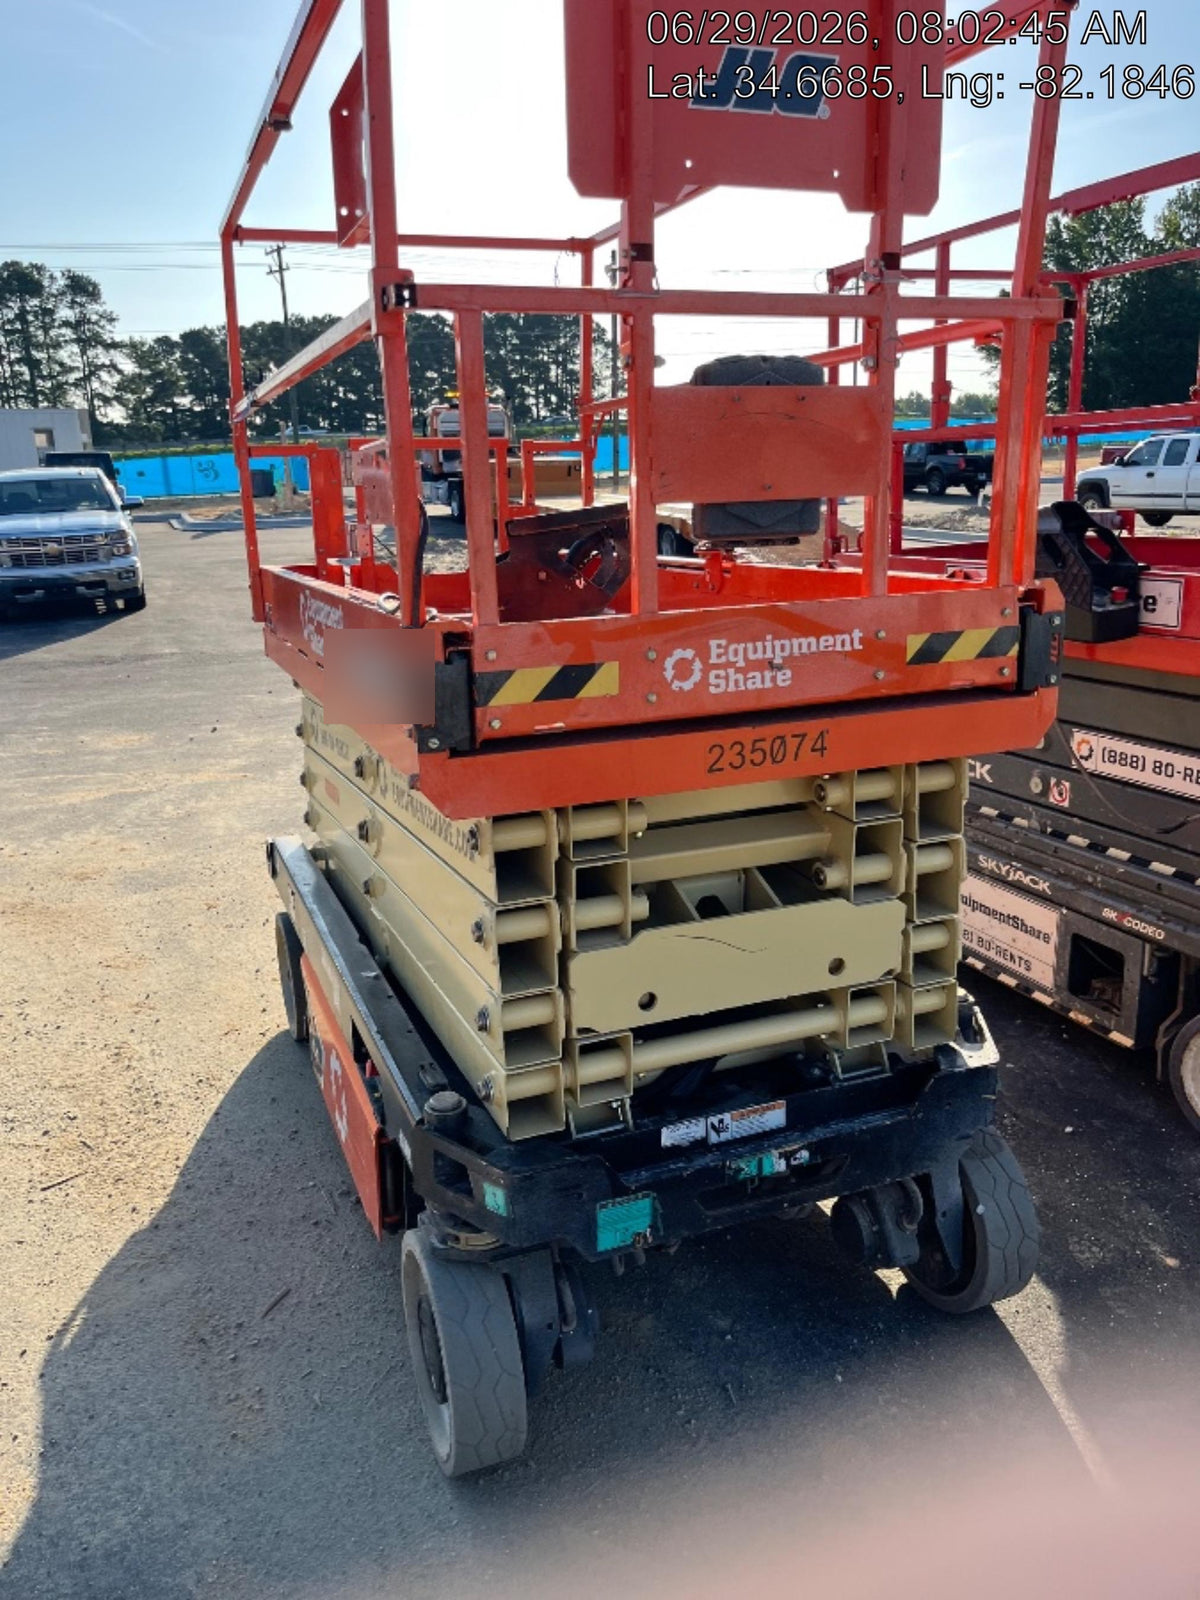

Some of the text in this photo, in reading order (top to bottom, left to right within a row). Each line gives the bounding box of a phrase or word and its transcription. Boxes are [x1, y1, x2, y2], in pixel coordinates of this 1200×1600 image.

[708, 628, 864, 667] Equipment
[708, 668, 793, 694] Share
[707, 730, 830, 774] 235074
[1102, 746, 1146, 772] (888)
